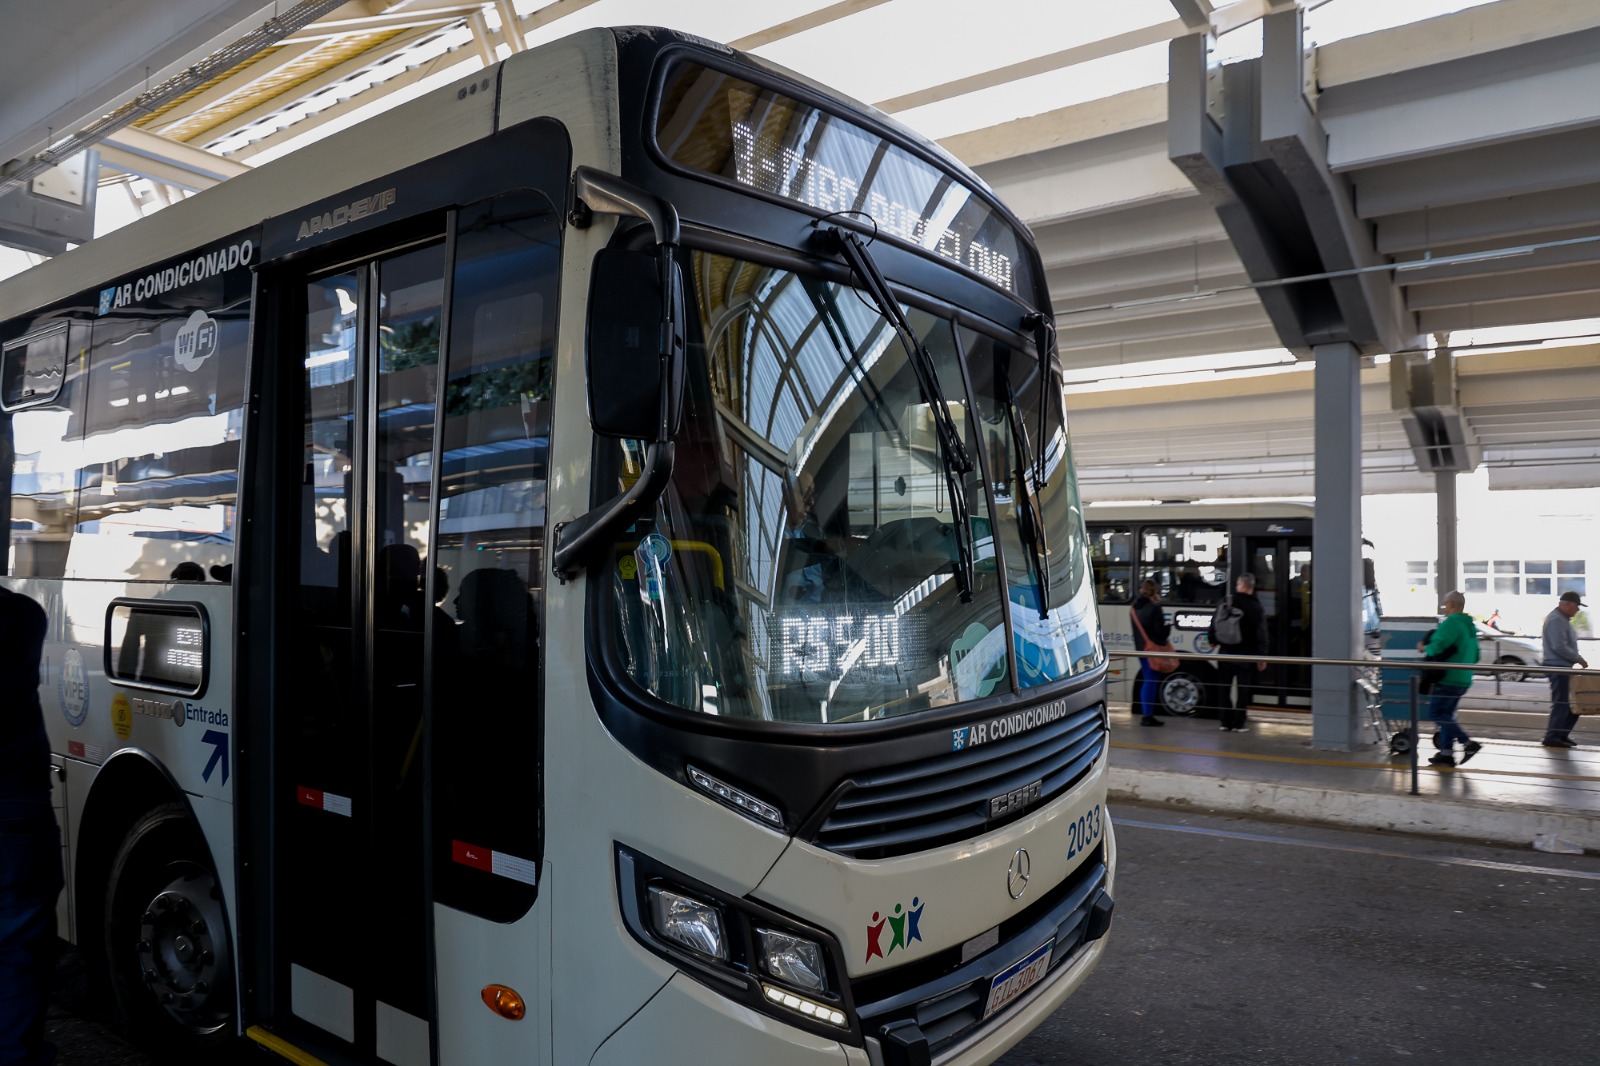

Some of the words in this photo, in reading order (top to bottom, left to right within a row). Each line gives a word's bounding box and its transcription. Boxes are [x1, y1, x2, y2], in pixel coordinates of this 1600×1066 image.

[113, 286, 132, 309] AR
[134, 239, 253, 302] CONDICIONADO
[186, 702, 229, 727] Entrada
[969, 724, 987, 747] AR
[990, 699, 1067, 741] CONDICIONADO
[1066, 804, 1101, 861] 2033
